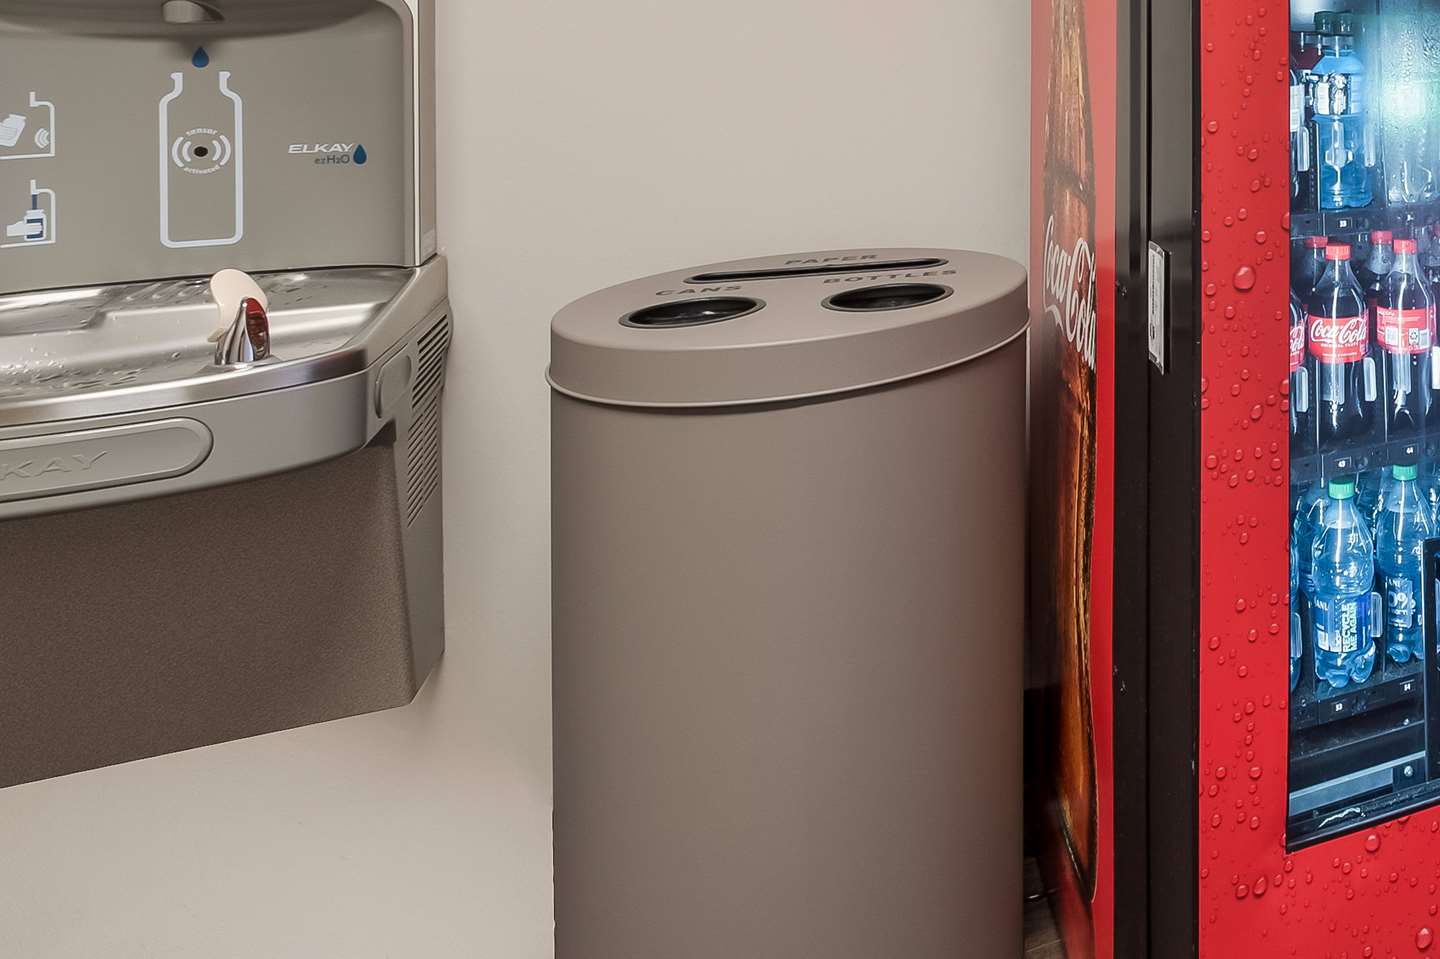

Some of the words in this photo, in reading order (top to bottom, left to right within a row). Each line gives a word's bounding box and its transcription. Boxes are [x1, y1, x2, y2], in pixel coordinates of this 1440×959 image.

[185, 128, 218, 136] sensor
[288, 143, 353, 154] ELKAY
[183, 164, 221, 175] activated
[784, 254, 878, 266] PAPER
[822, 269, 957, 284] BOTTLES
[655, 285, 741, 296] CANS
[1044, 215, 1097, 374] Coca-Cola
[0, 449, 108, 481] KAY
[1349, 602, 1358, 634] AGAIN
[1341, 603, 1350, 652] RECYCLE
